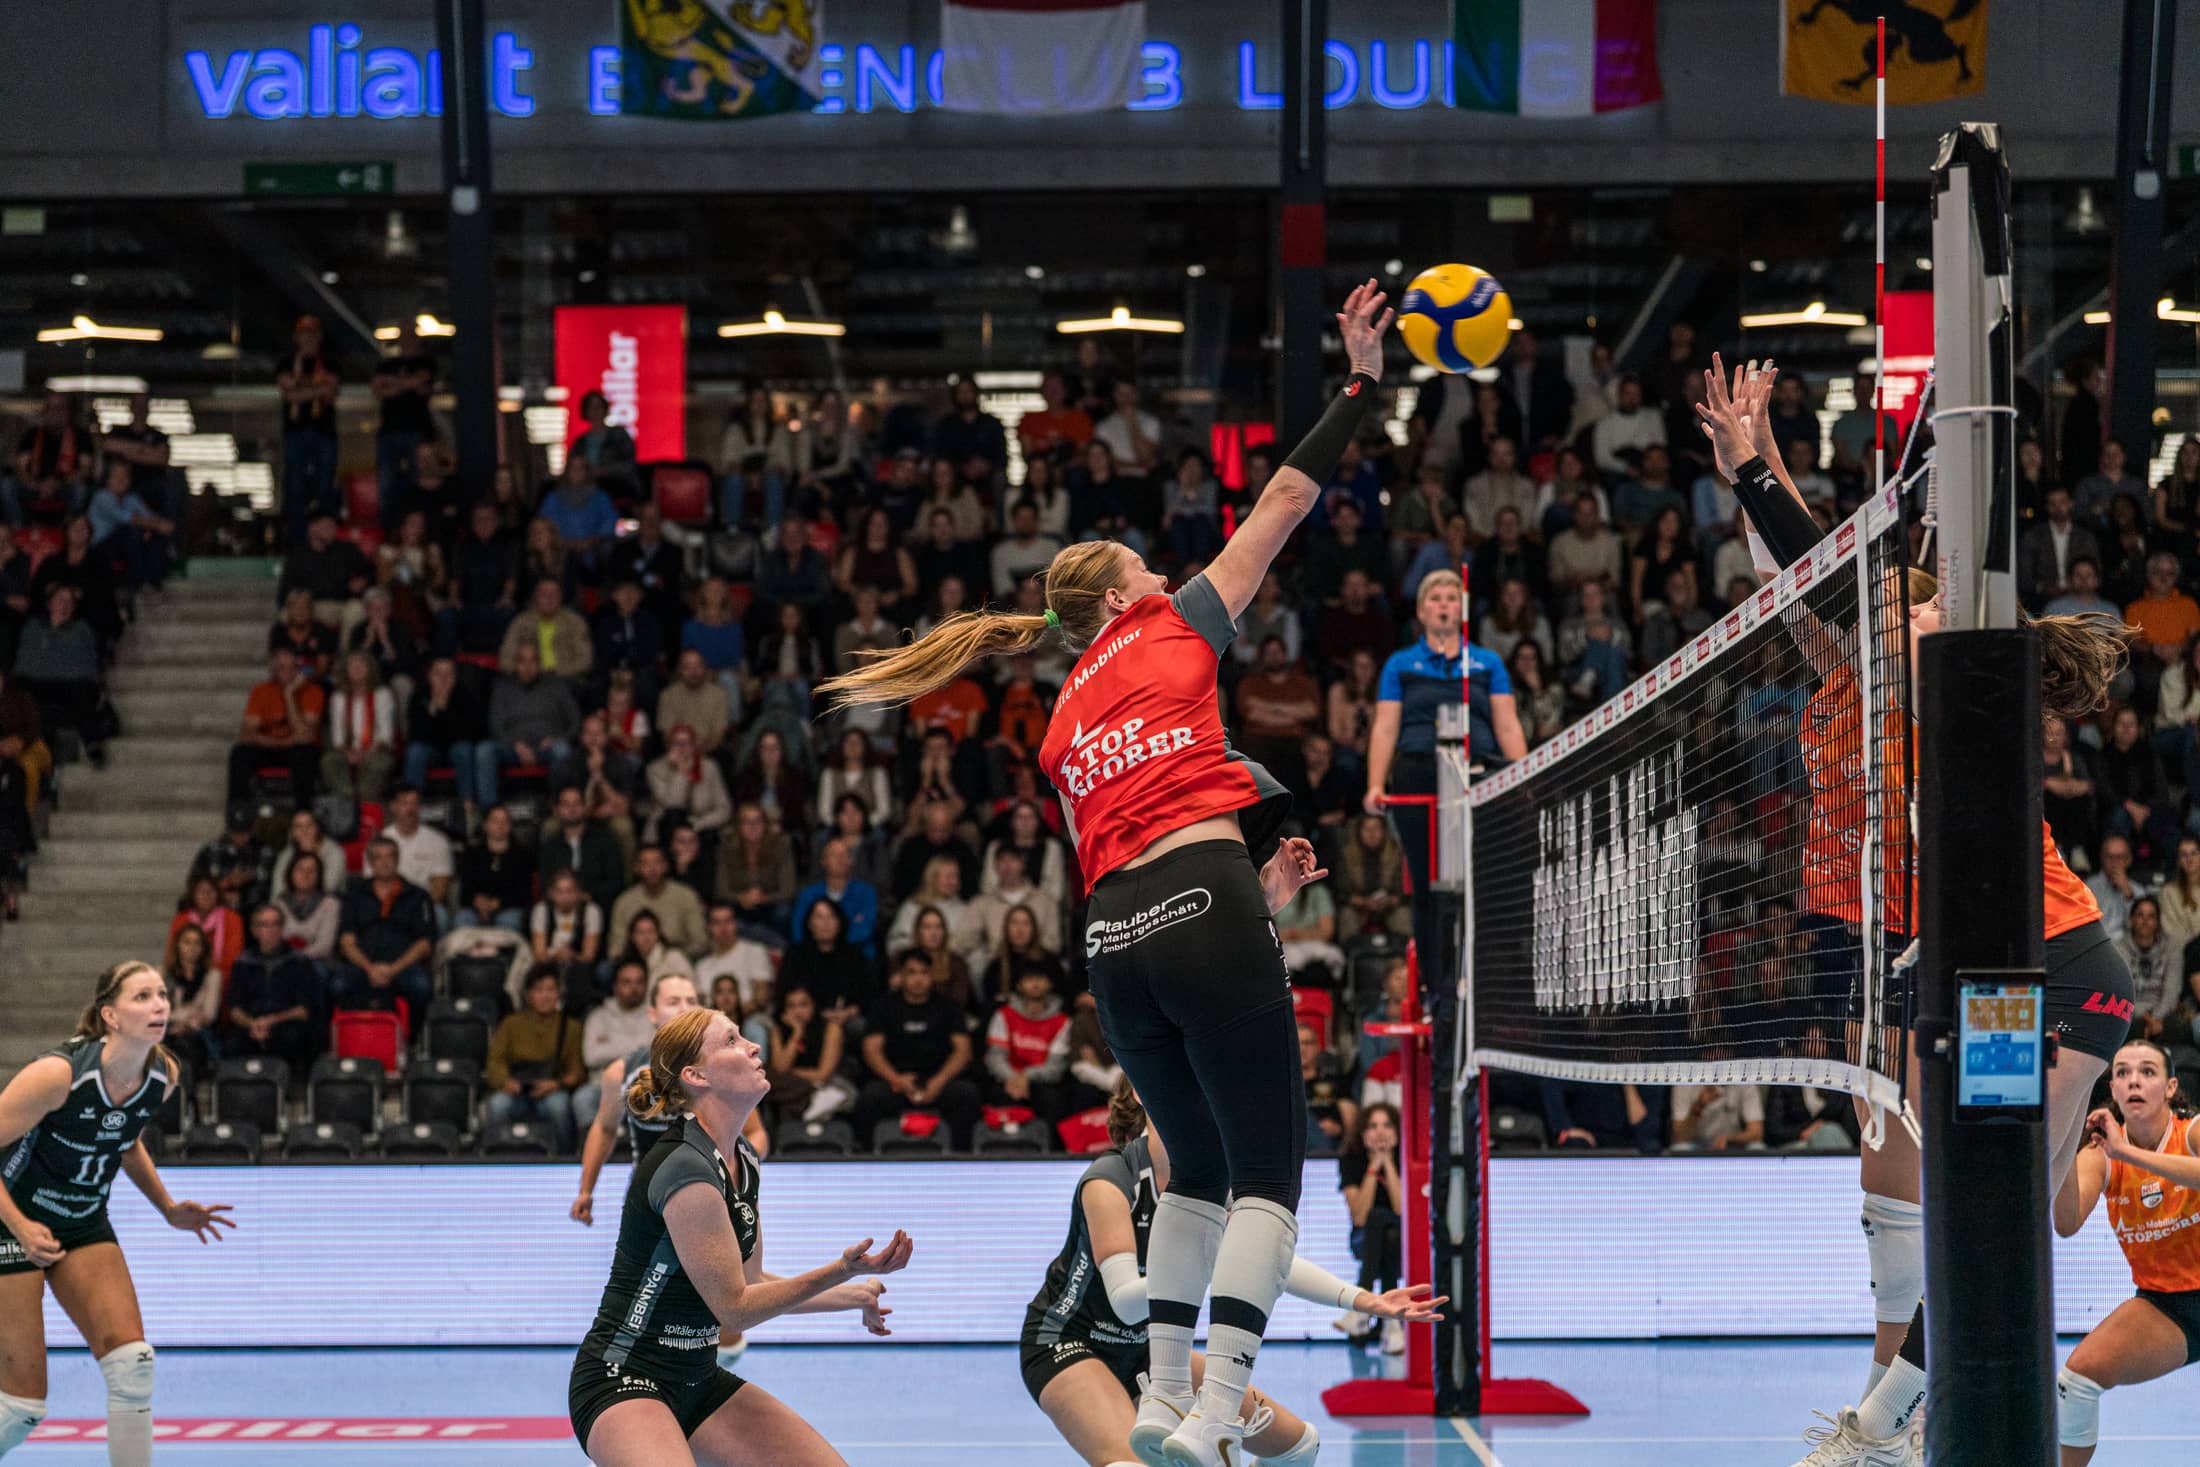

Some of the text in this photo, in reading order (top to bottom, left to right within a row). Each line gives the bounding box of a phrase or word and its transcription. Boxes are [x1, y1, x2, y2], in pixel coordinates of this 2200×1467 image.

[1073, 627, 1142, 691] Mobiliar
[1080, 717, 1144, 769] TOP
[1086, 901, 1167, 958] Stauber
[75, 1154, 109, 1185] 11
